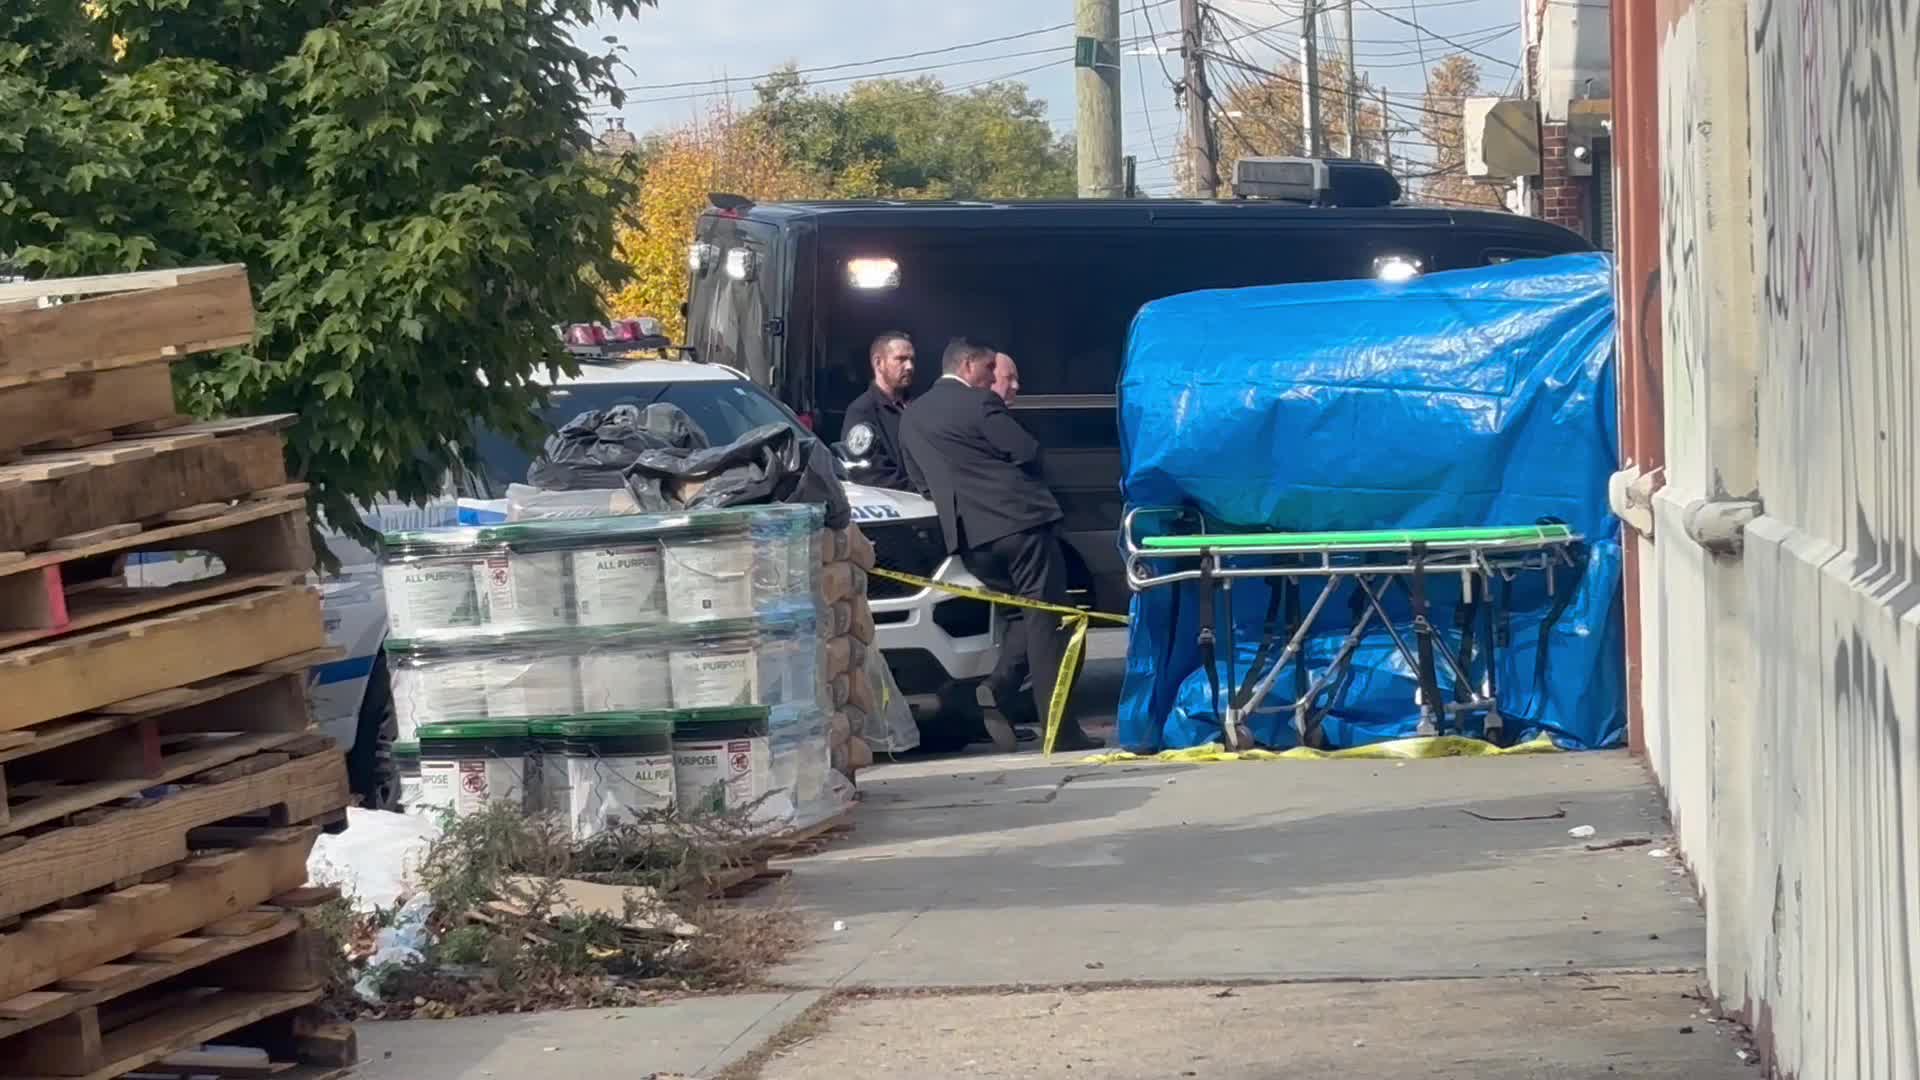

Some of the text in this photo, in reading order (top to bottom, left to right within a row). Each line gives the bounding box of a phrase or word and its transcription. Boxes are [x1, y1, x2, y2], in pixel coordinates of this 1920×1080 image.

[851, 505, 900, 519] ICE
[596, 560, 616, 570] ALL
[405, 574, 424, 584] ALL
[678, 755, 717, 766] URPOSE
[635, 770, 653, 781] ALL
